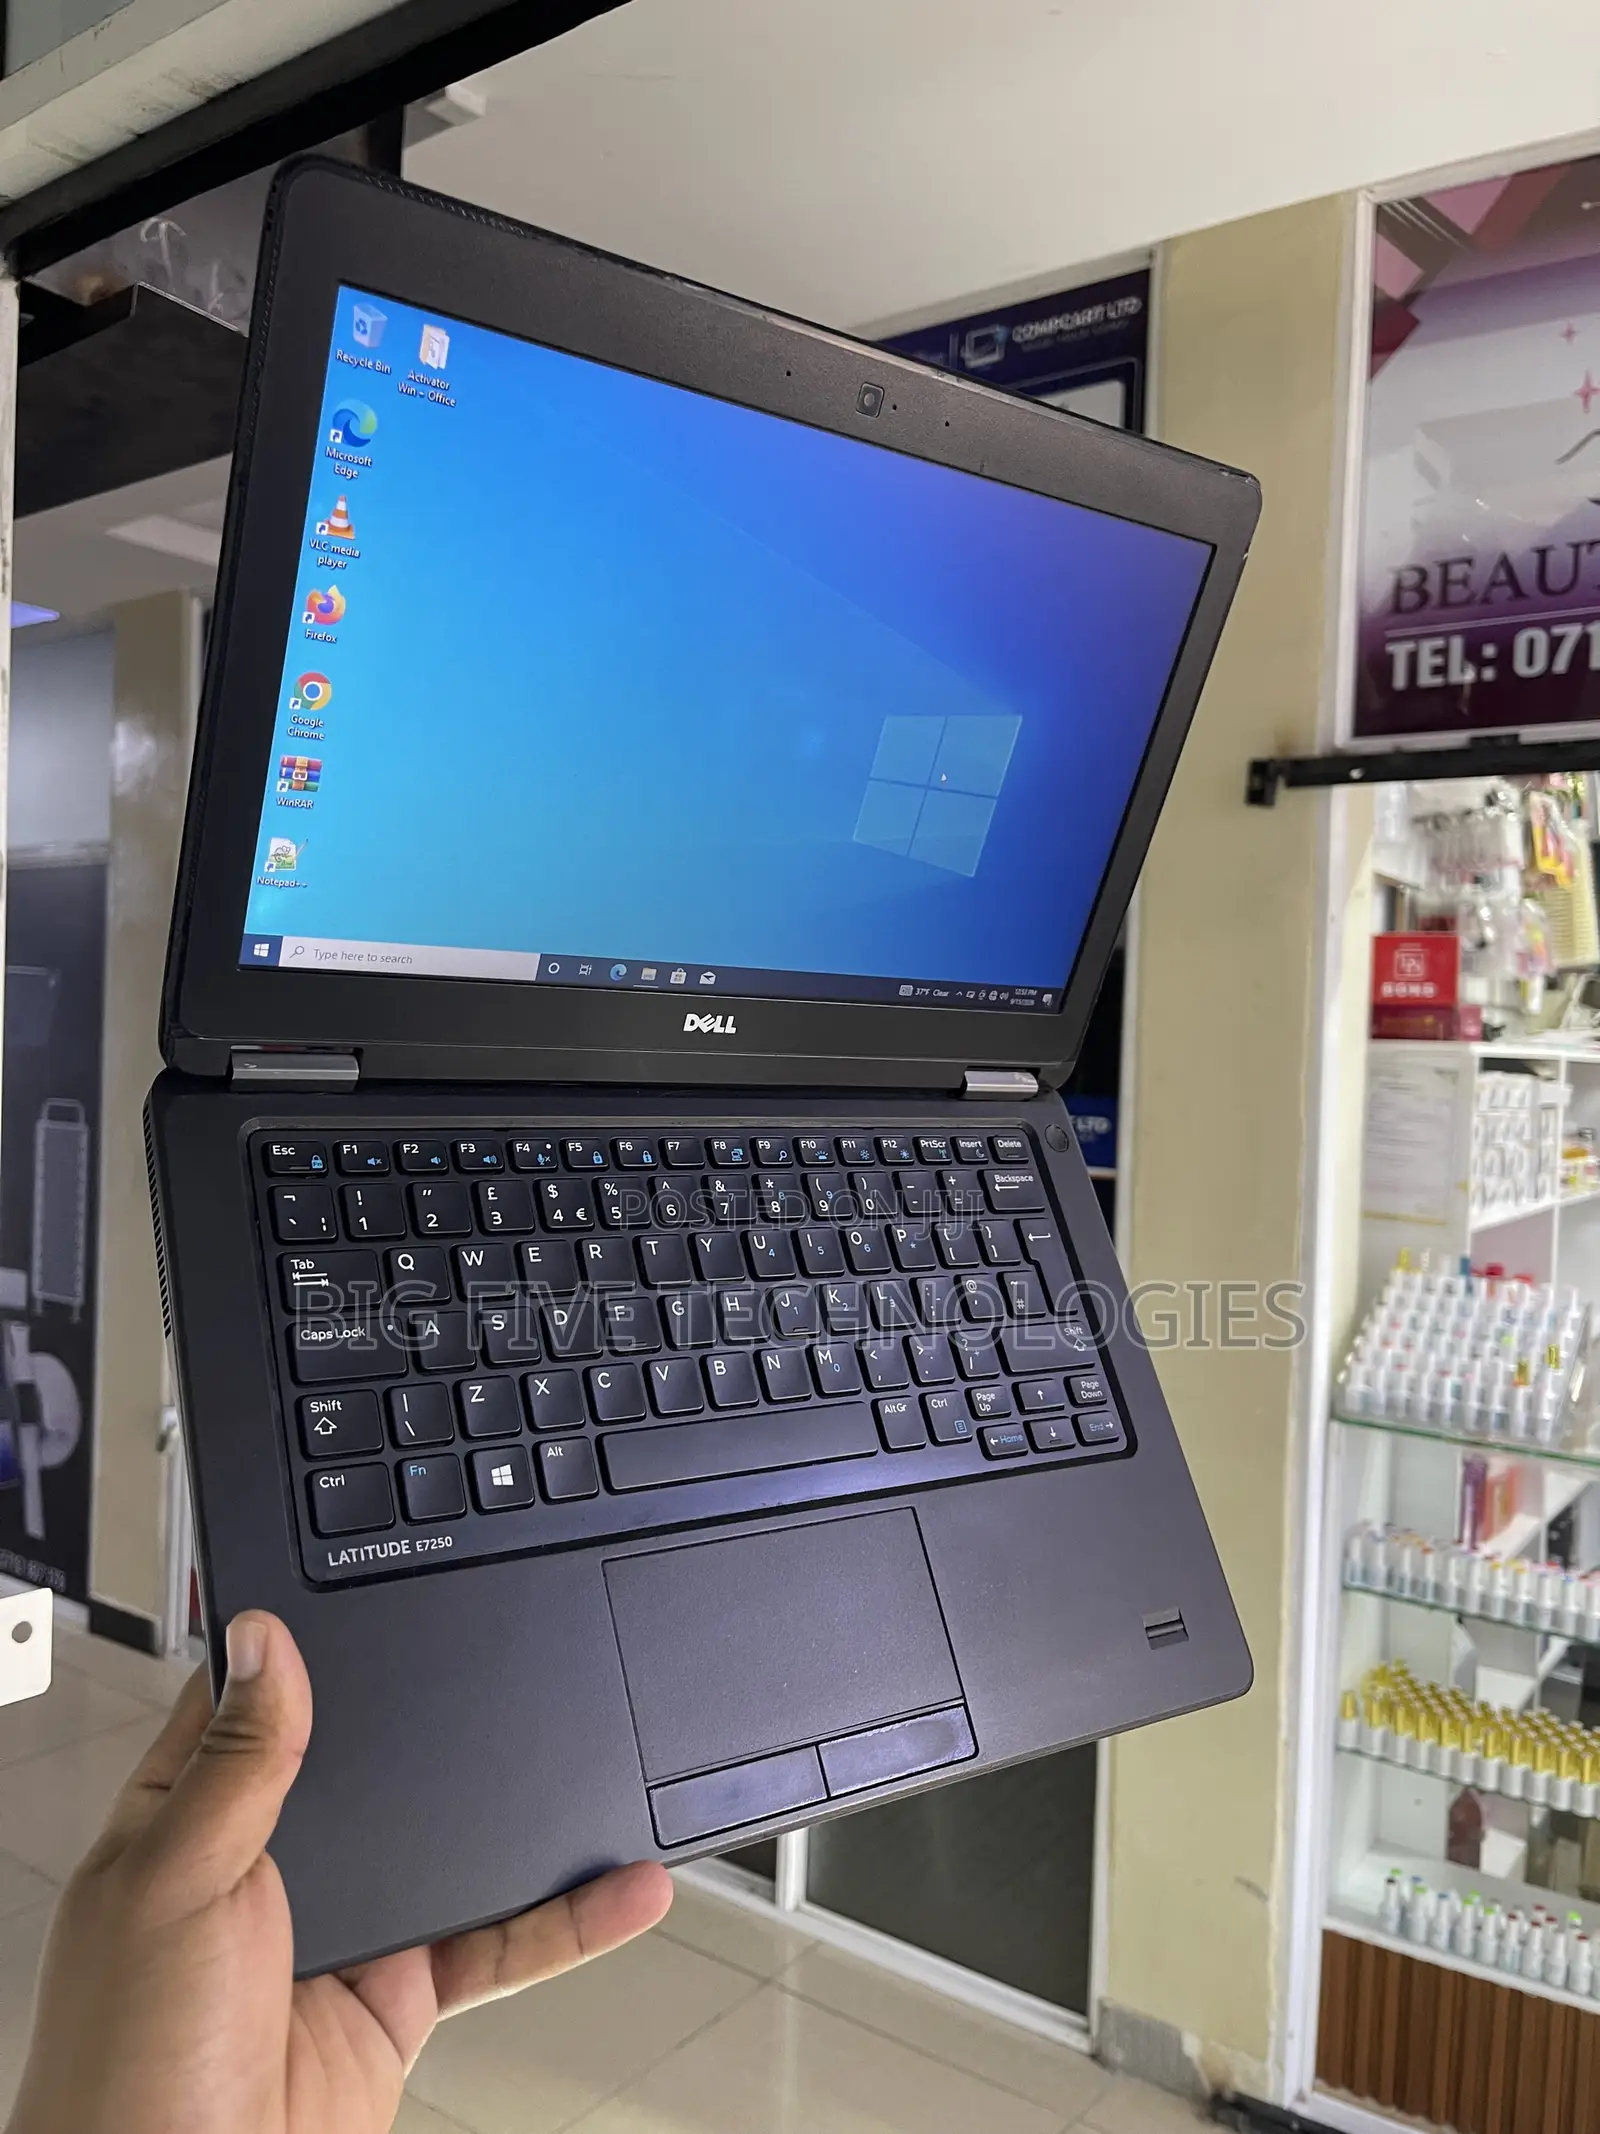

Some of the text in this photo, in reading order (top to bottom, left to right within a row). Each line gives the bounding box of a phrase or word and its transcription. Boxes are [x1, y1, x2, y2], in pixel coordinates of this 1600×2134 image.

[336, 349, 391, 375] Recycle Bin
[408, 369, 450, 391] Activator
[398, 381, 417, 398] Win
[427, 388, 457, 407] Office
[325, 445, 373, 468] Microsoft
[334, 463, 359, 480] Edge
[309, 537, 361, 559] VLC media
[317, 555, 348, 570] player
[305, 628, 338, 644] Firefox
[1385, 634, 1498, 691] TEL:
[290, 714, 325, 729] Google
[287, 726, 325, 742] Chrome
[276, 796, 314, 810] WinRAR
[313, 949, 413, 965] Type here to search
[933, 989, 949, 997] Clear
[683, 1013, 737, 1034] DELL
[272, 1145, 296, 1156] Esc
[343, 1145, 358, 1155] F1
[403, 1144, 419, 1154] F2
[460, 1143, 476, 1154] F3
[516, 1143, 530, 1153] F4
[568, 1142, 583, 1152] F5
[619, 1141, 633, 1151] F6
[667, 1141, 680, 1151] F7
[714, 1141, 727, 1150] F8
[758, 1140, 771, 1150] F9
[801, 1140, 816, 1149] F10
[842, 1140, 856, 1149] F11
[882, 1139, 897, 1149] F12
[920, 1139, 947, 1148] PrtScr
[959, 1139, 982, 1148] Insert
[997, 1139, 1022, 1148] Delete
[994, 1174, 1034, 1183] Backspace
[487, 1186, 498, 1200] £
[547, 1183, 559, 1199] $
[604, 1182, 618, 1196] %
[715, 1180, 727, 1192] &
[356, 1190, 363, 1206] !
[865, 1198, 875, 1210] 0
[611, 1206, 622, 1219] 5
[666, 1203, 677, 1217] 6
[719, 1202, 729, 1215] 7
[771, 1201, 781, 1213] 8
[818, 1200, 829, 1212] 9
[426, 1213, 439, 1227] 2
[491, 1211, 503, 1225] 3
[553, 1208, 588, 1222] 4 €
[358, 1217, 368, 1231] 1
[753, 1235, 766, 1250] U
[806, 1233, 813, 1247] I
[851, 1231, 863, 1245] O
[896, 1229, 907, 1242] P
[588, 1244, 603, 1259] R
[646, 1240, 658, 1255] T
[700, 1237, 712, 1252] Y
[817, 1246, 825, 1255] 5
[863, 1243, 871, 1253] 6
[462, 1250, 484, 1266] W
[528, 1246, 542, 1262] E
[768, 1248, 775, 1257] 4
[291, 1258, 315, 1270] Tab
[397, 1253, 415, 1271] Q
[877, 1286, 888, 1300] L
[965, 1279, 977, 1293] @
[780, 1292, 790, 1308] J
[828, 1289, 841, 1304] K
[671, 1300, 685, 1316] G
[726, 1296, 740, 1312] H
[553, 1309, 568, 1325] D
[614, 1305, 626, 1321] F
[424, 1319, 440, 1336] A
[490, 1314, 505, 1331] S
[300, 1326, 366, 1342] Caps Lock
[1064, 1326, 1084, 1337] Shift
[766, 1354, 781, 1370] N
[817, 1349, 833, 1364] M
[655, 1365, 670, 1382] V
[713, 1360, 727, 1376] B
[535, 1378, 551, 1396] X
[597, 1372, 612, 1389] C
[1081, 1380, 1100, 1391] Page
[469, 1385, 485, 1403] Z
[976, 1392, 996, 1402] Page
[1081, 1389, 1103, 1399] Down
[310, 1398, 342, 1413] Shift
[931, 1397, 948, 1409] Ctrl
[979, 1402, 991, 1412] Up
[1000, 1434, 1024, 1444] Home
[547, 1445, 563, 1459] Alt
[409, 1464, 427, 1477] Fn
[319, 1473, 346, 1489] Ctrl
[328, 1535, 453, 1567] LATITUDE E7250
